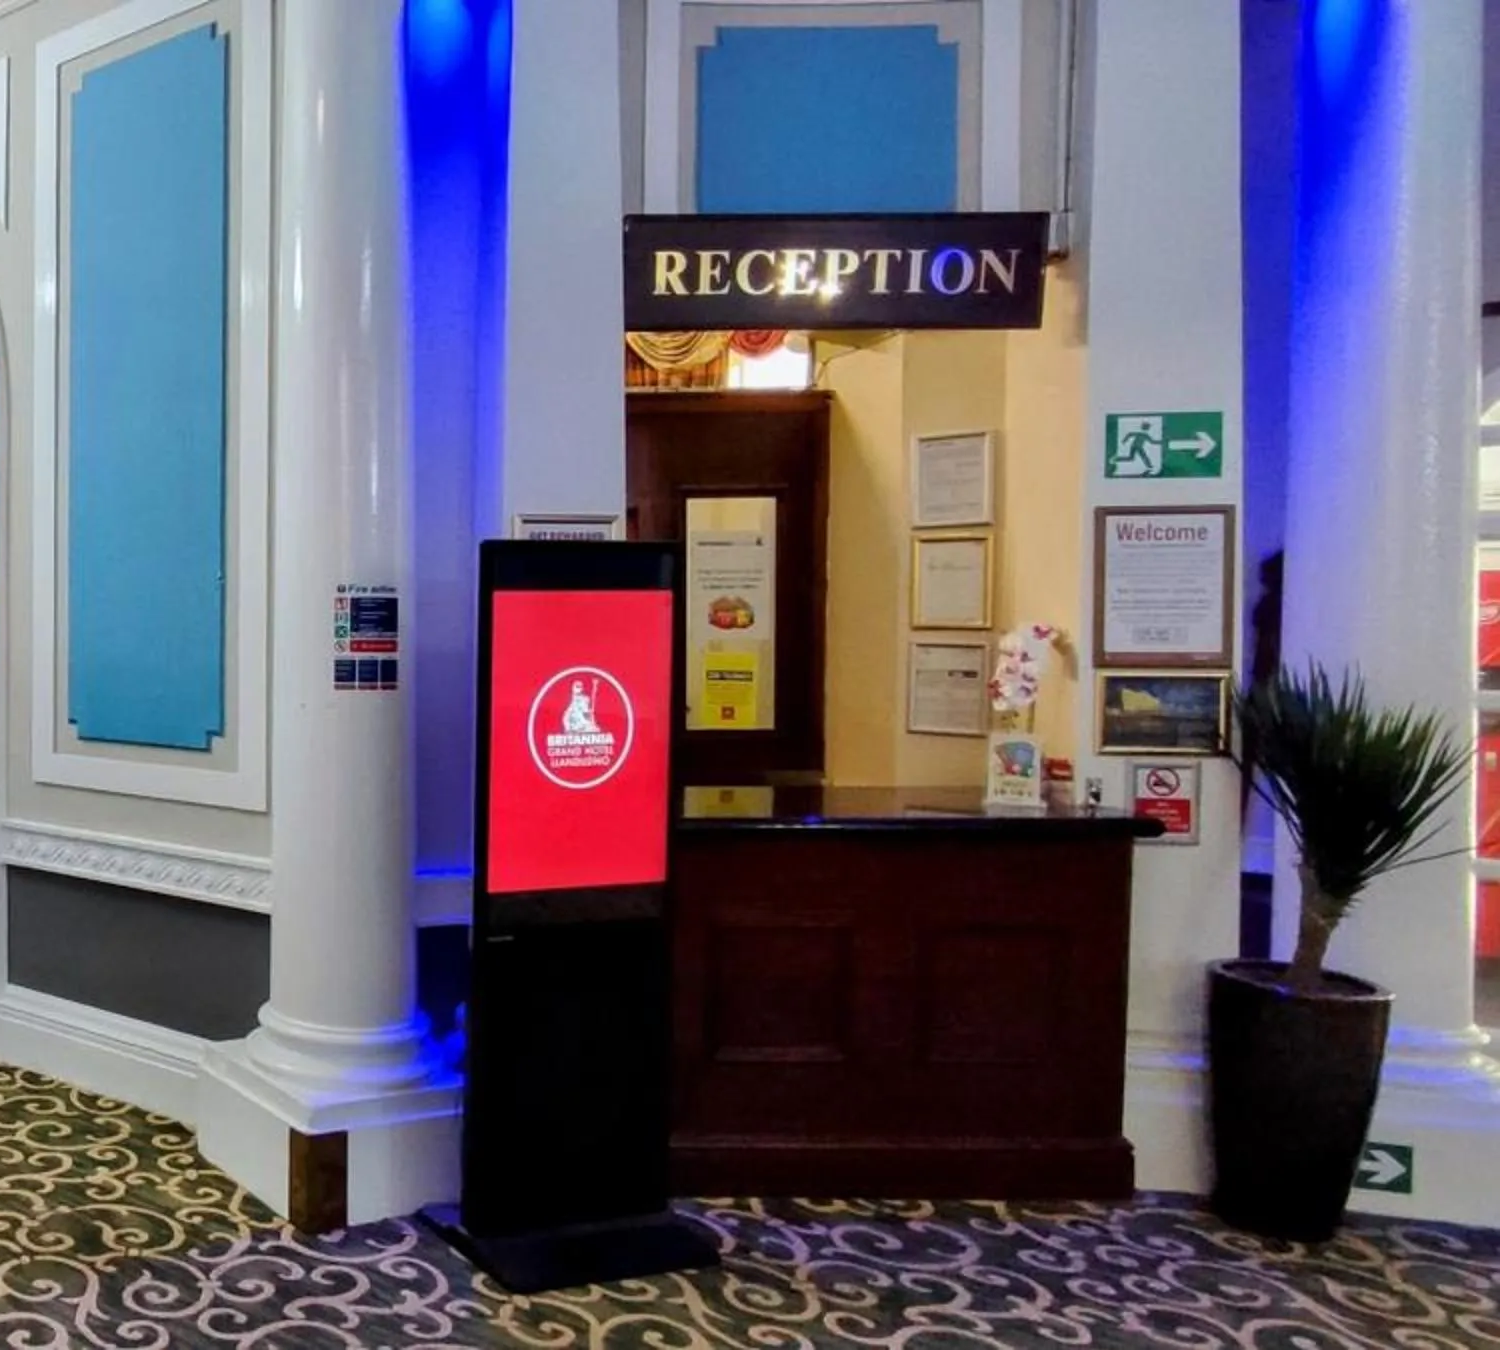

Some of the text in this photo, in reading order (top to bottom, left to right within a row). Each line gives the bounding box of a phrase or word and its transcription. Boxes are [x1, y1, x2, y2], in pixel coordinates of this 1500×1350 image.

[652, 247, 1023, 297] RECEPTION
[1116, 521, 1208, 541] Welcome
[547, 733, 615, 747] BRITANNIA
